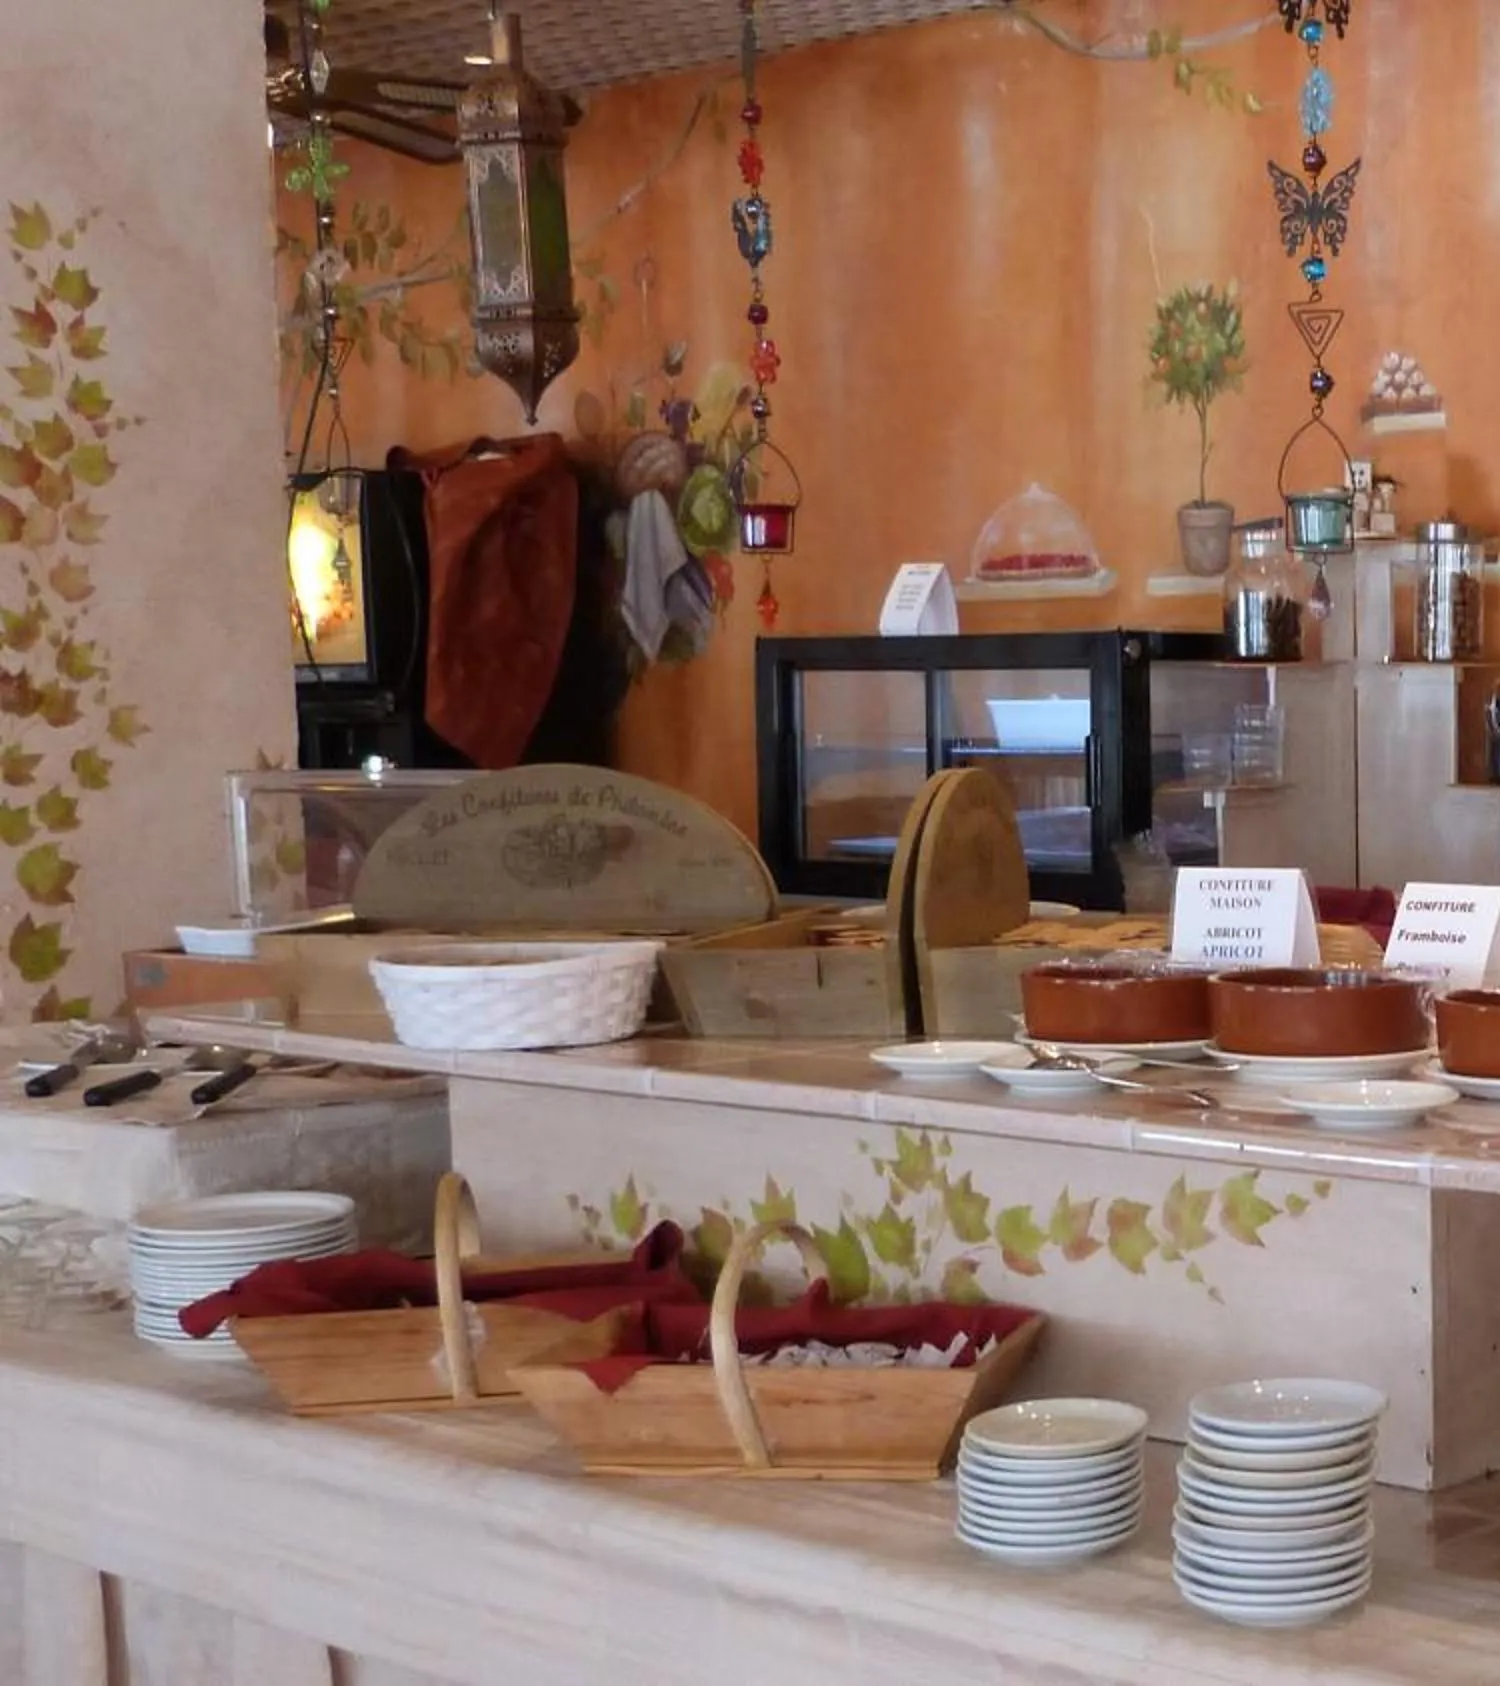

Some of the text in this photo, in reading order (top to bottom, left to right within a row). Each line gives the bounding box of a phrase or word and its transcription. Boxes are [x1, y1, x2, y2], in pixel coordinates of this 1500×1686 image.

[1199, 879, 1274, 892] CONFITURE
[1209, 896, 1262, 909] MAISON
[1405, 900, 1476, 913] CONFITURE
[1204, 927, 1262, 940] ABRICOT
[1398, 929, 1467, 945] Framboise
[1201, 945, 1263, 960] APRICOT
